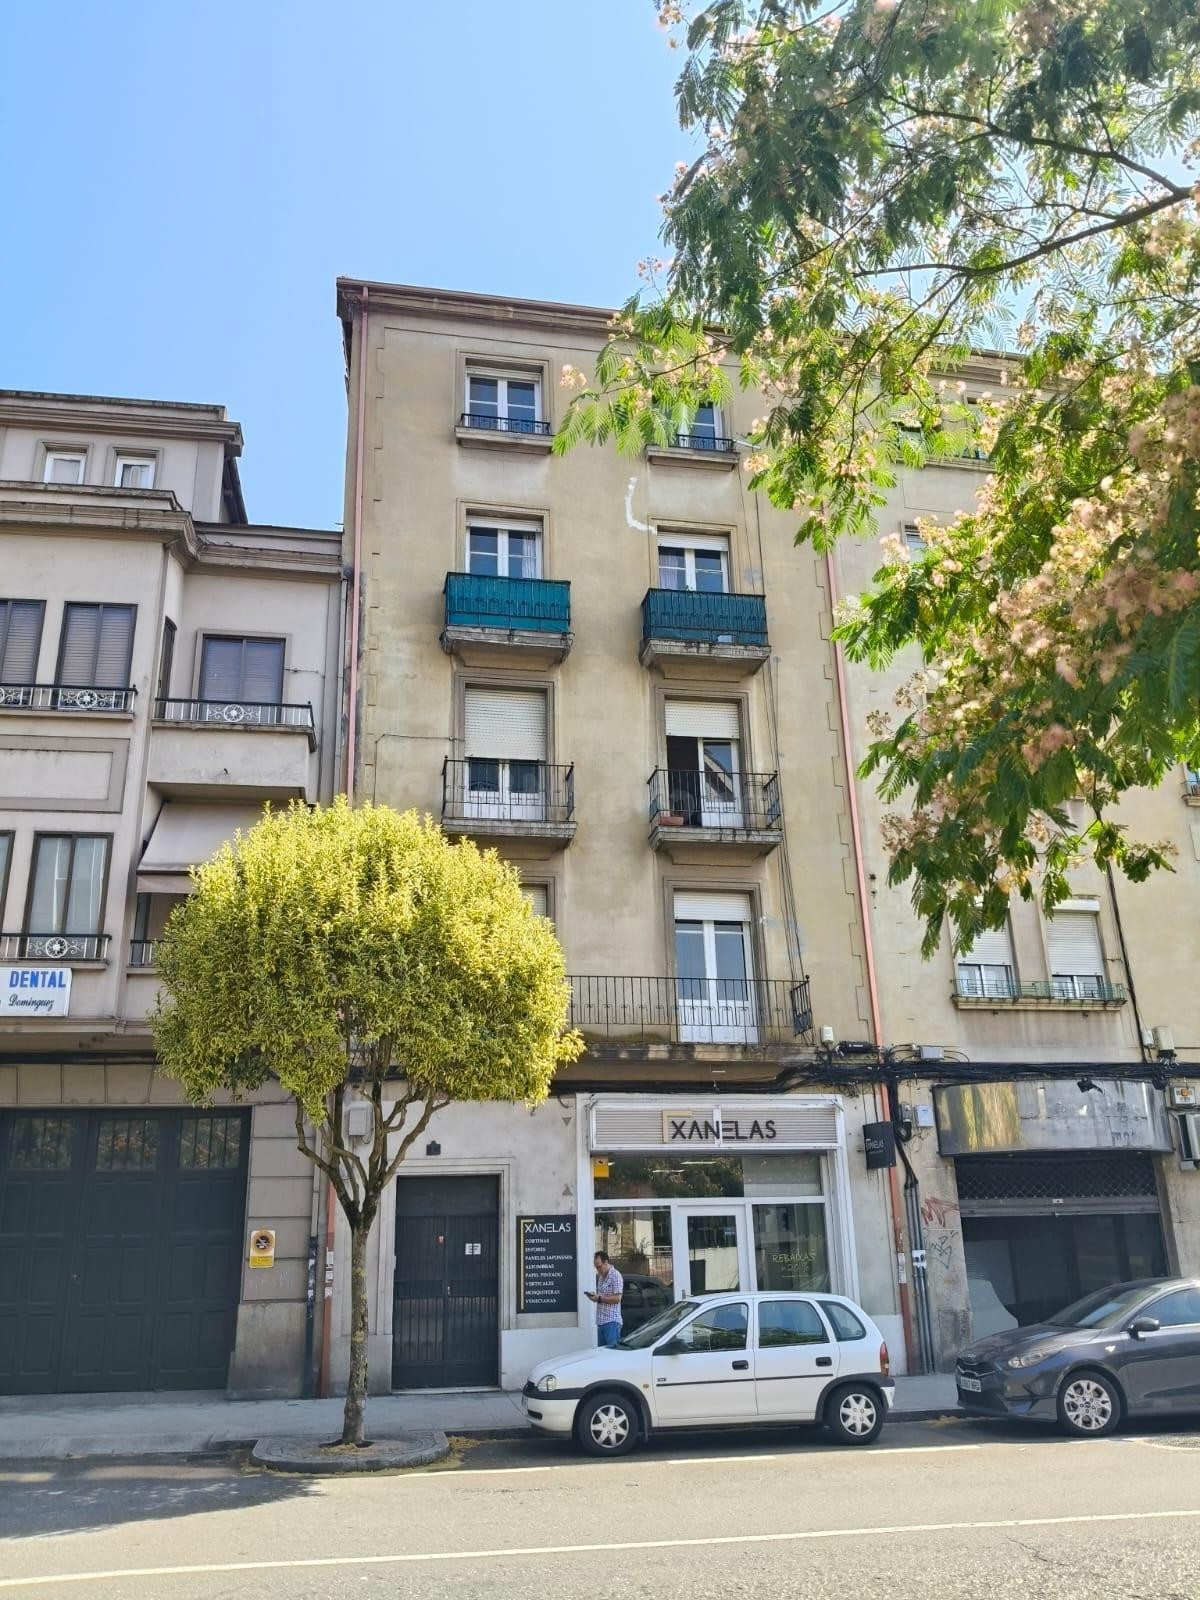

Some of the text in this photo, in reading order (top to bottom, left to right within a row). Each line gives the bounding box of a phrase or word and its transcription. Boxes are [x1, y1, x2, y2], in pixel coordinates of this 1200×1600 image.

[9, 970, 67, 988] DENTAL
[671, 1120, 777, 1140] XANELAS
[524, 1222, 572, 1233] XANELAS
